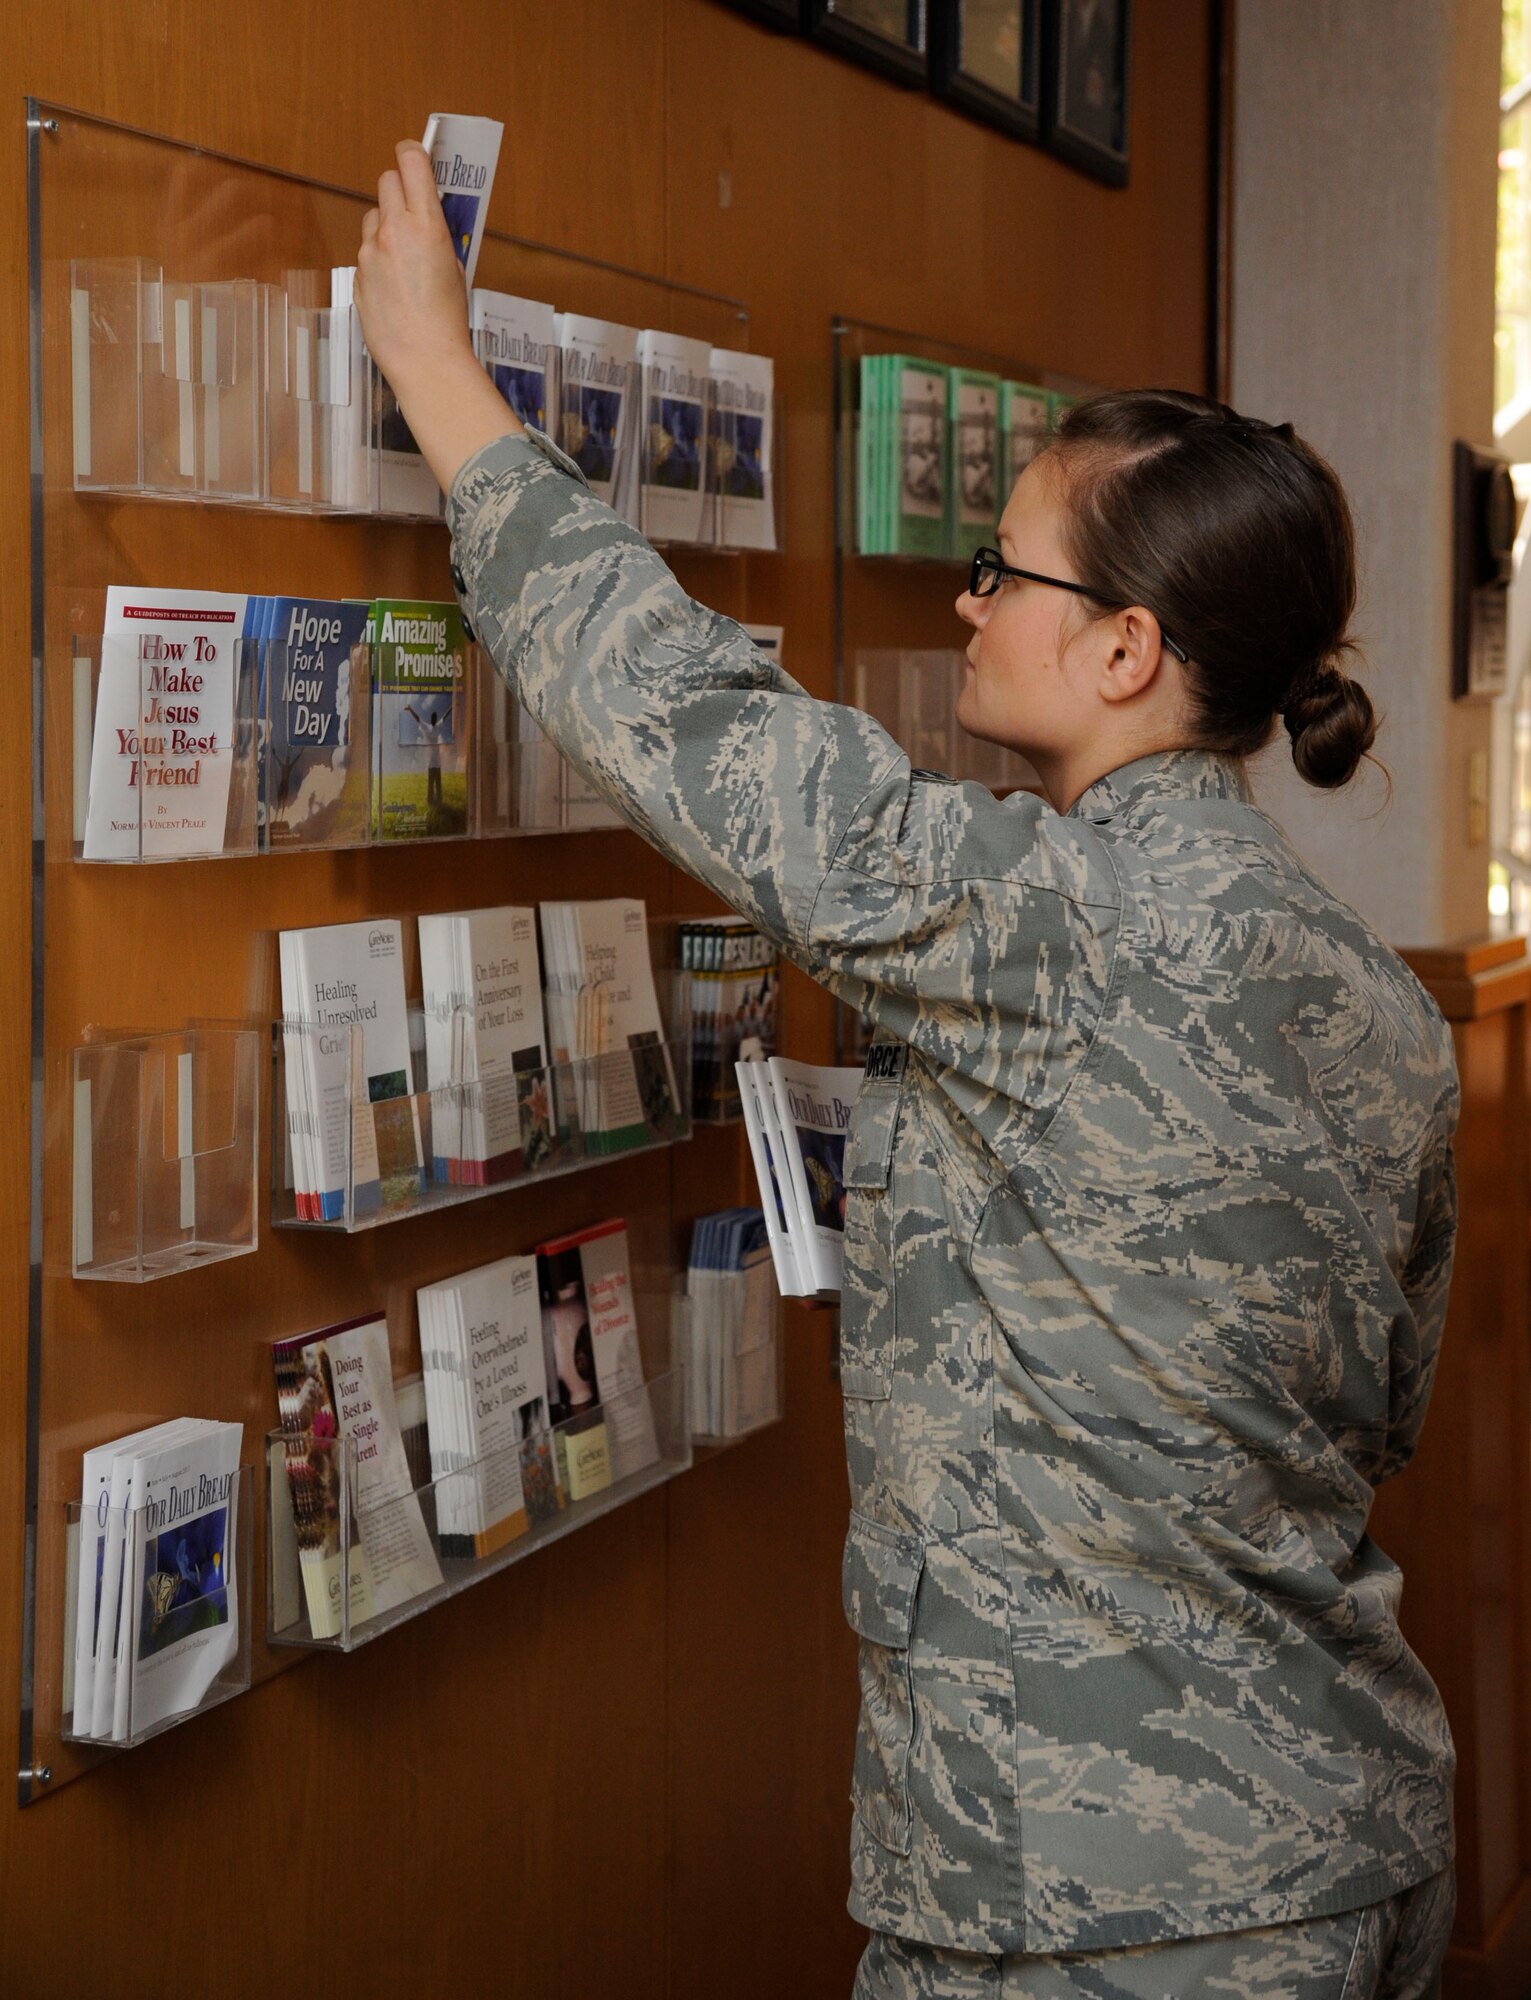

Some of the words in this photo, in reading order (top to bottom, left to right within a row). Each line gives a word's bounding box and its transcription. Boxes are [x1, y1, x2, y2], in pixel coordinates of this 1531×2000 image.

[450, 153, 487, 190] BREAD
[133, 610, 170, 618] GUIDEPOSTS
[288, 607, 342, 652] Hope
[380, 611, 447, 652] Amazing
[141, 634, 188, 662] How
[193, 635, 217, 663] To
[293, 649, 314, 671] For
[314, 650, 325, 672] A
[395, 645, 463, 679] Promises
[147, 665, 204, 693] Make
[281, 671, 323, 703] New
[144, 697, 200, 724] Jesus
[293, 704, 332, 745] Day
[116, 728, 166, 756] Your
[170, 729, 219, 755] Best
[127, 759, 202, 788] Friend
[148, 819, 180, 830] VINCENT
[181, 818, 207, 829] PEALE
[501, 957, 519, 976] First
[315, 980, 358, 1003] Healing
[477, 984, 523, 1007] Anniversary
[317, 1000, 378, 1029] Unresolved
[486, 1010, 506, 1028] Your
[506, 1007, 525, 1025] Loss
[319, 1034, 346, 1056] Gri
[865, 1046, 901, 1077] ORCE
[470, 1321, 501, 1347] Feeling
[472, 1326, 529, 1370] Overwhelmed
[335, 1356, 364, 1376] Doing
[338, 1381, 360, 1398] Your
[342, 1401, 361, 1421] Best
[362, 1399, 372, 1413] as
[352, 1417, 379, 1440] Single
[356, 1443, 378, 1463] rent
[146, 1494, 166, 1533] OUR
[167, 1485, 197, 1523] DAILY
[197, 1473, 231, 1511] BREAD
